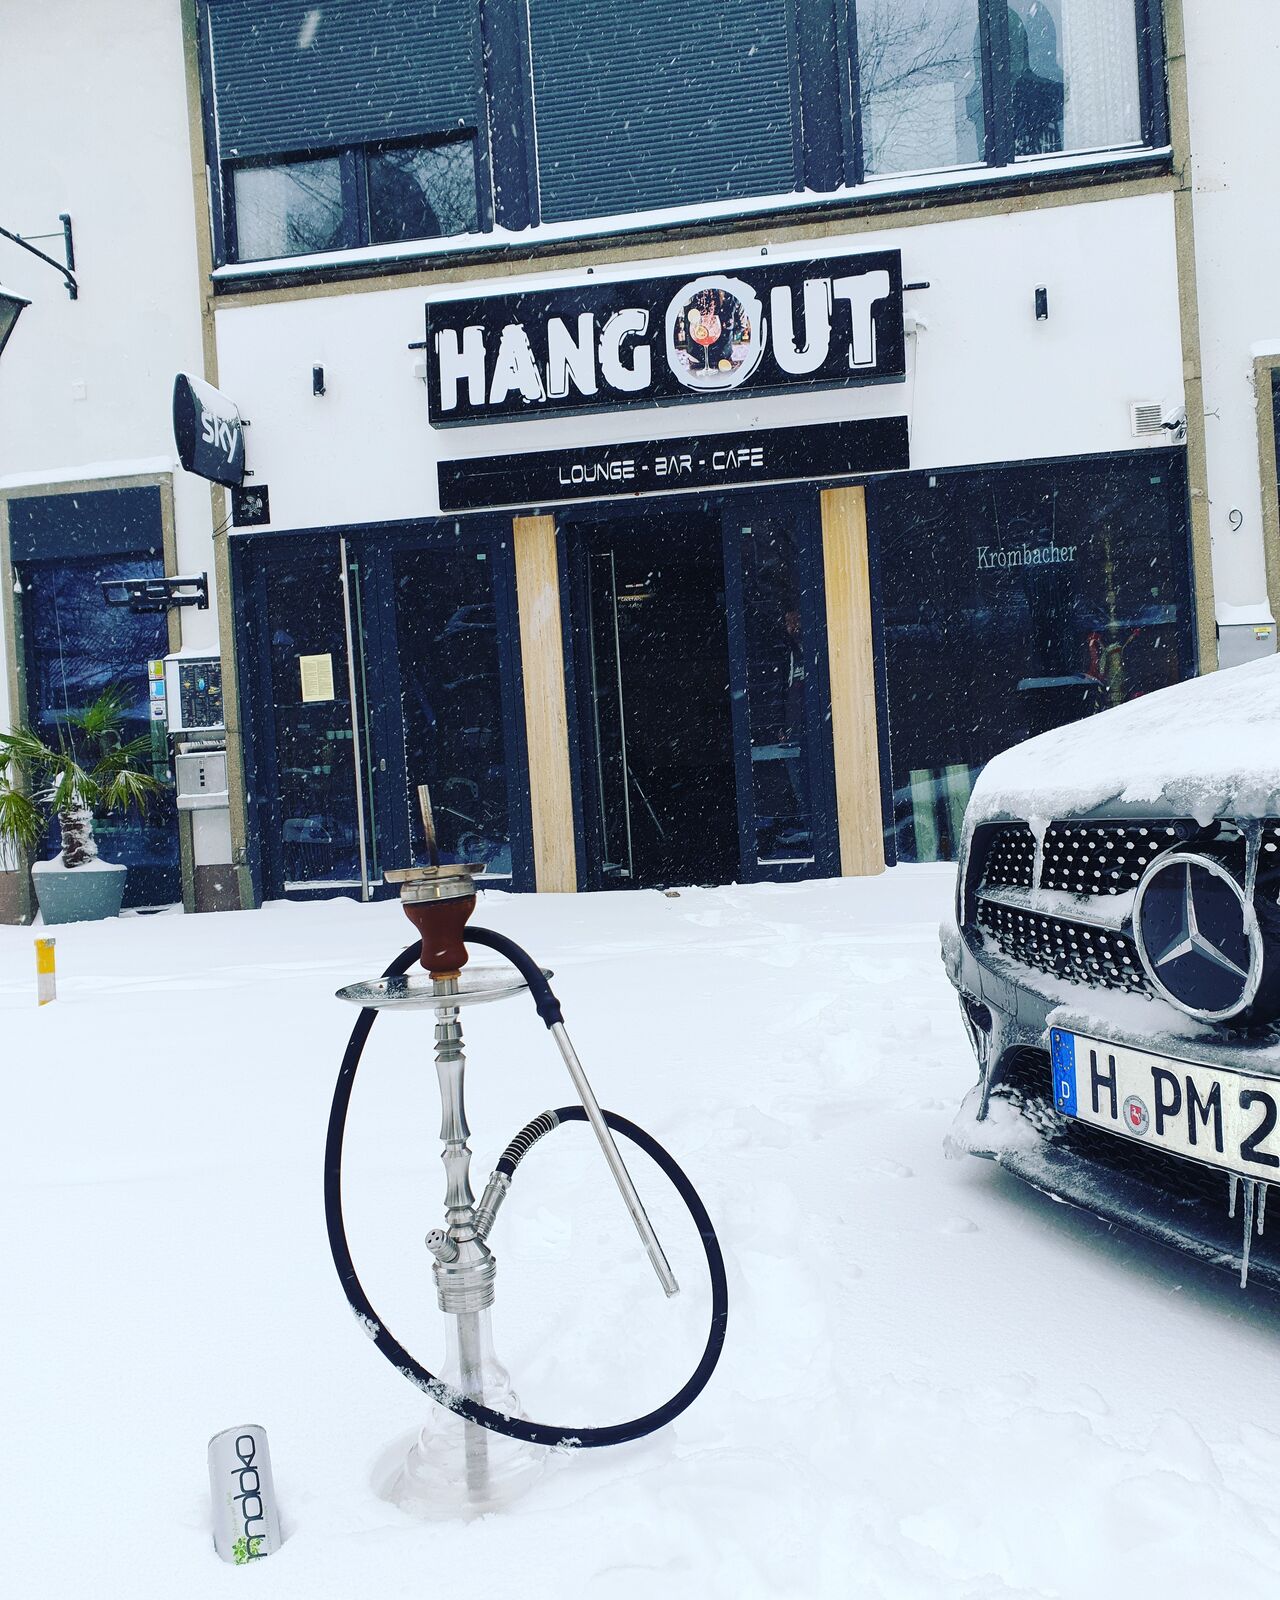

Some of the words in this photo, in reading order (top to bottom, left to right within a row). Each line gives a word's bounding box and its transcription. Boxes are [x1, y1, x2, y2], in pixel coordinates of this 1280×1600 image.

[558, 459, 635, 485] LOUNGE
[654, 454, 692, 476] BAR
[712, 447, 764, 471] CAFE
[1228, 508, 1243, 532] 9
[976, 541, 1078, 569] Krombacher
[1061, 1080, 1071, 1099] D
[1089, 1049, 1118, 1120] H
